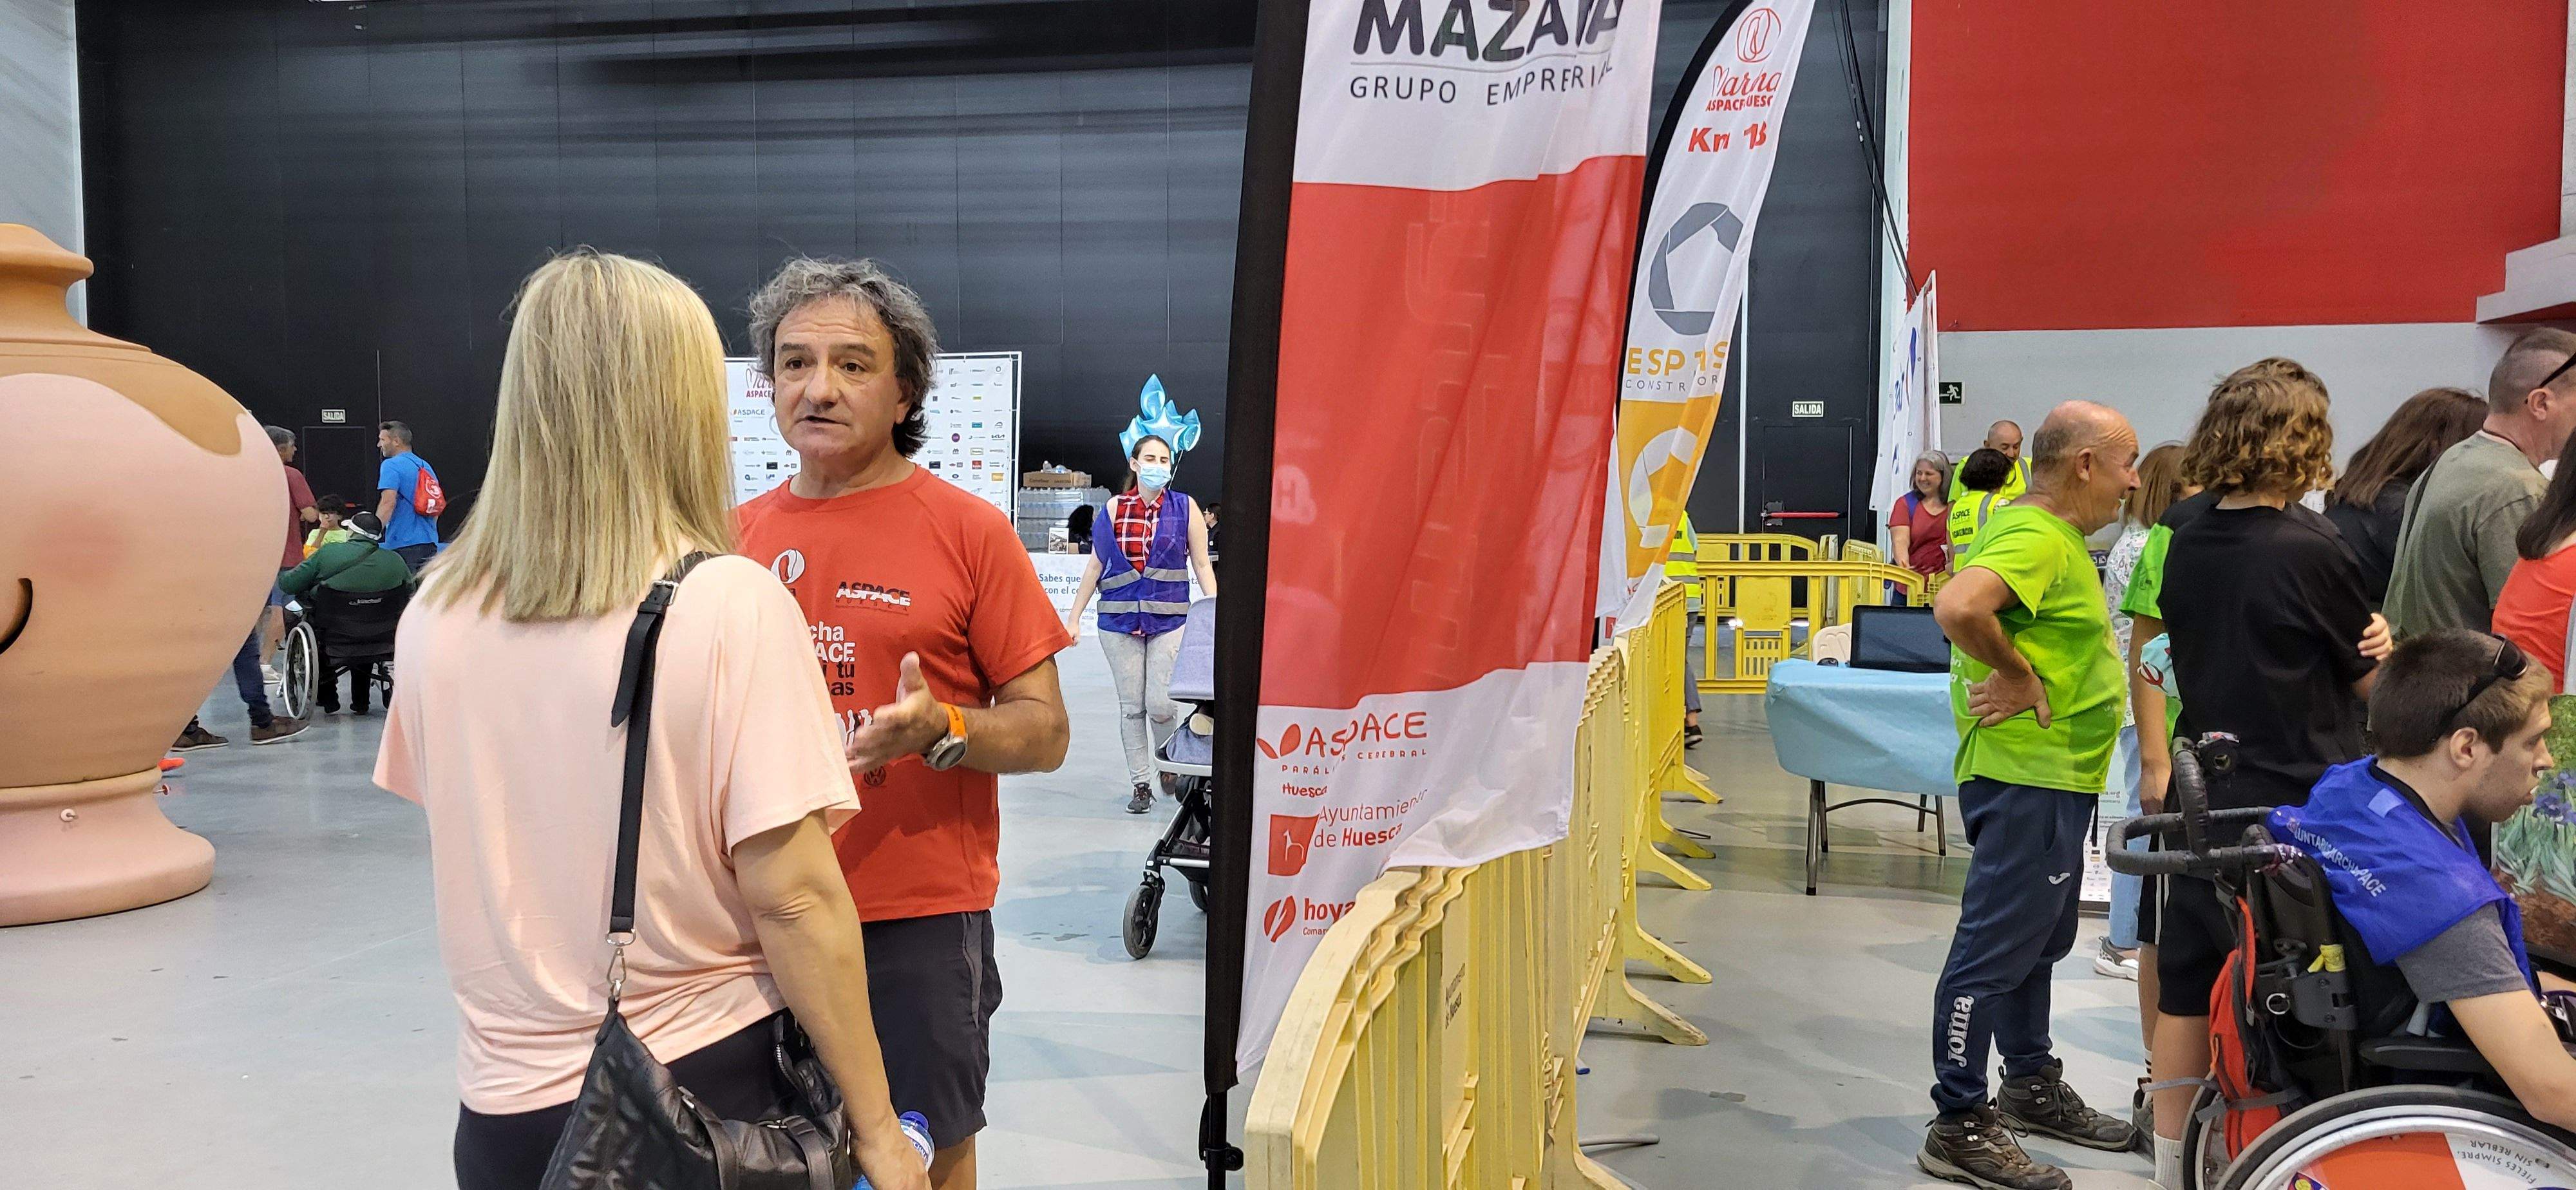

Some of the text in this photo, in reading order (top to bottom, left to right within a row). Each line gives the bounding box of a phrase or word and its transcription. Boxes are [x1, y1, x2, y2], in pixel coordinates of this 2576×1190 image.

[1353, 0, 1624, 62] MAZAA
[1350, 75, 1457, 104] GRUPO
[323, 411, 344, 420] SALIDA
[1794, 404, 1822, 415] SALIDA
[1039, 573, 1082, 585] Sabes que
[1061, 585, 1069, 594] el
[835, 581, 912, 607] ASPACE
[1305, 712, 1427, 758] ASPACE
[1282, 782, 1328, 798] Huesca
[1314, 822, 1403, 848] de Huesca
[2470, 1140, 2533, 1167] SIN REBLAR
[2505, 1160, 2537, 1185] FIELES
